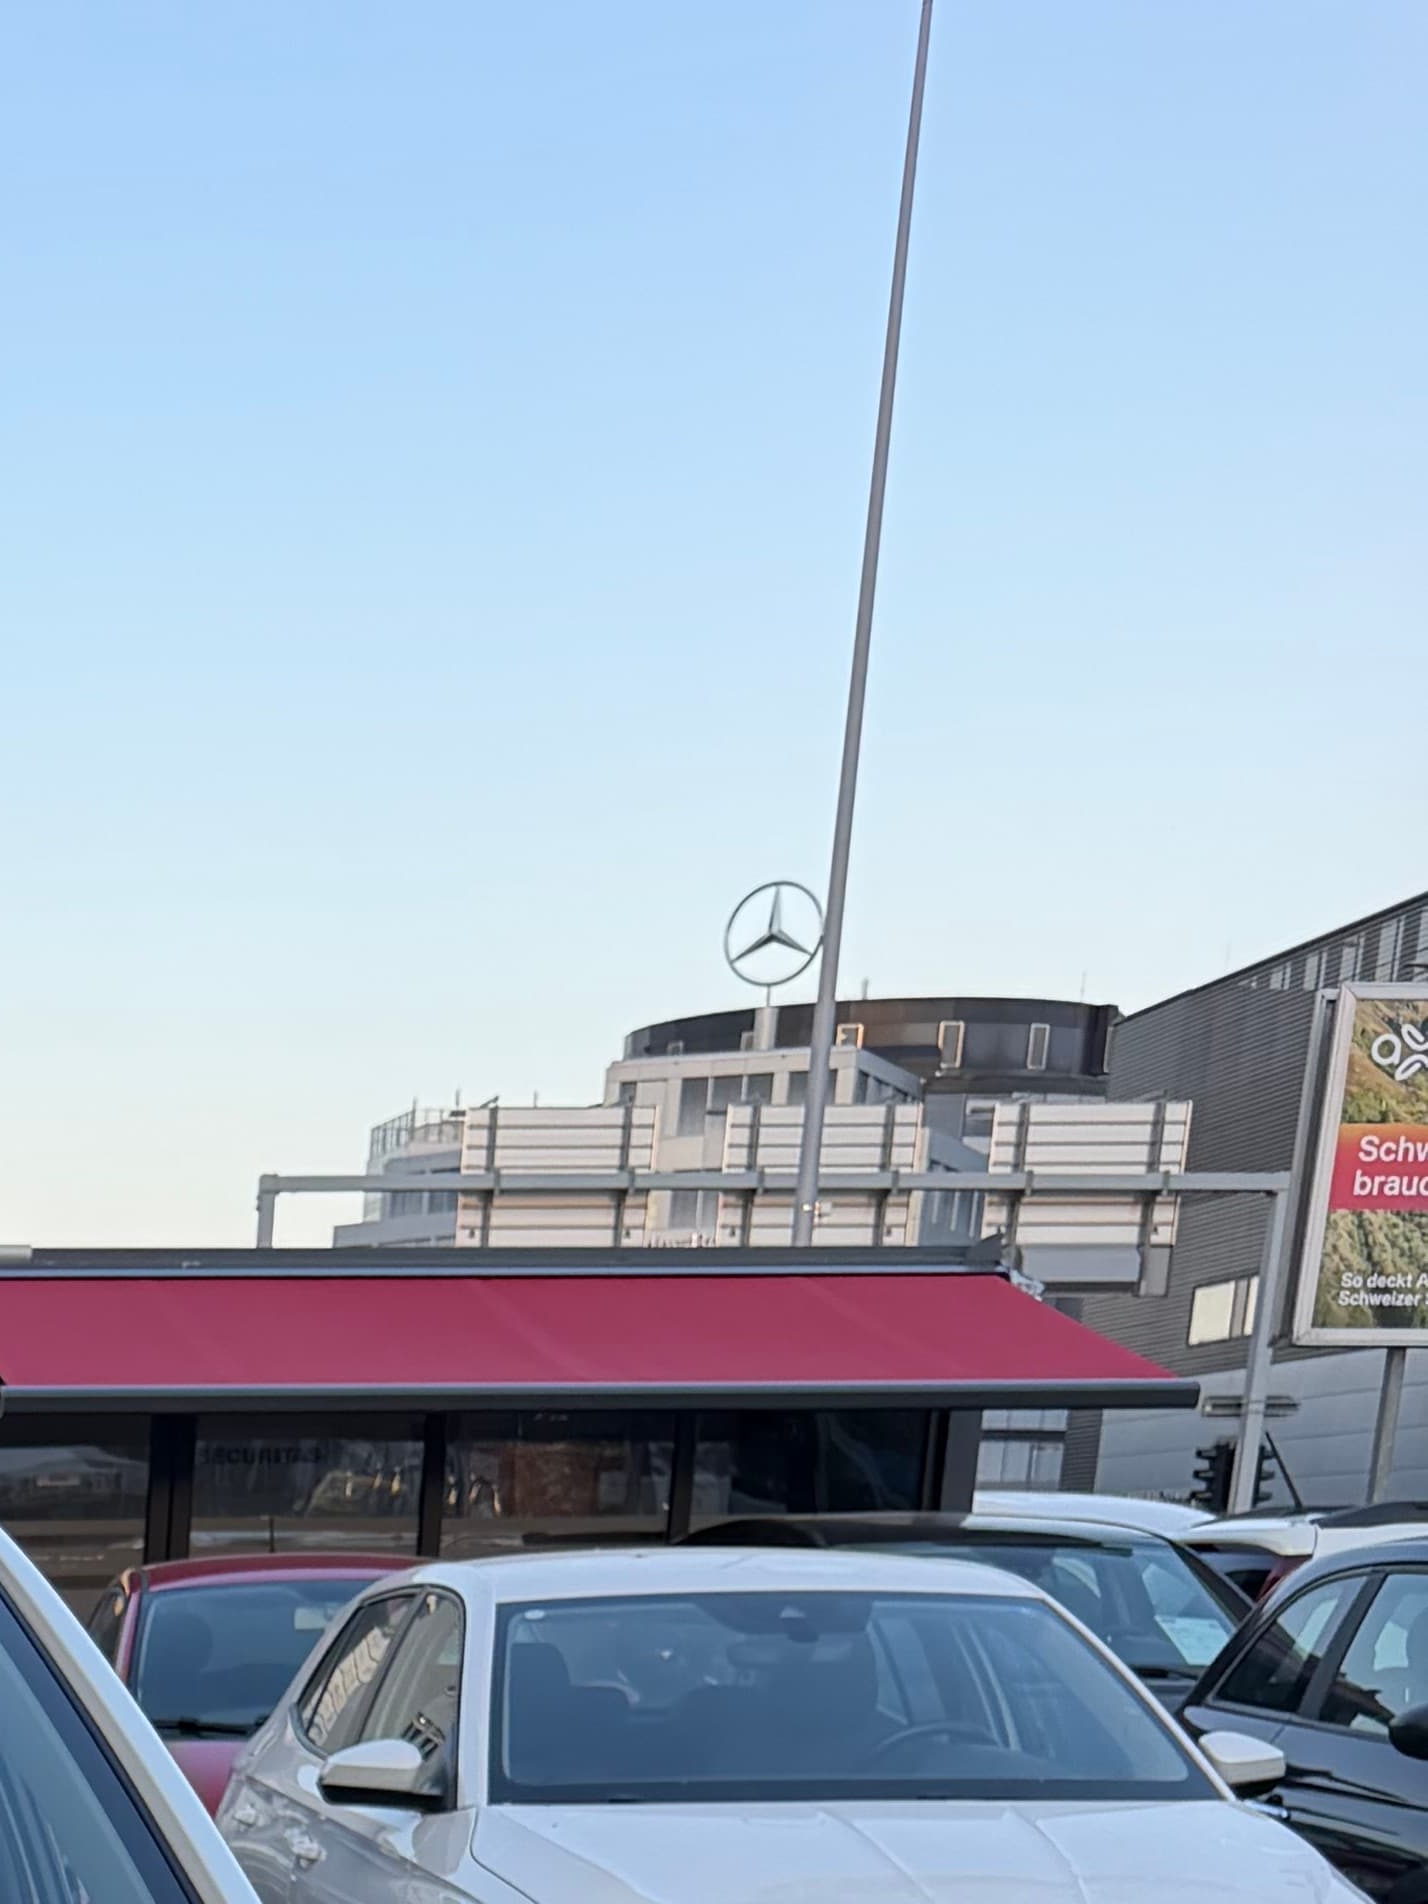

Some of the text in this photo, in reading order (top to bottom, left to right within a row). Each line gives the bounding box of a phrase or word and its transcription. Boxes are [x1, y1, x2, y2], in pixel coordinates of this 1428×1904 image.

[1341, 1271, 1363, 1288] So
[1366, 1271, 1413, 1289] deckt
[1337, 1290, 1421, 1307] Schweizer
